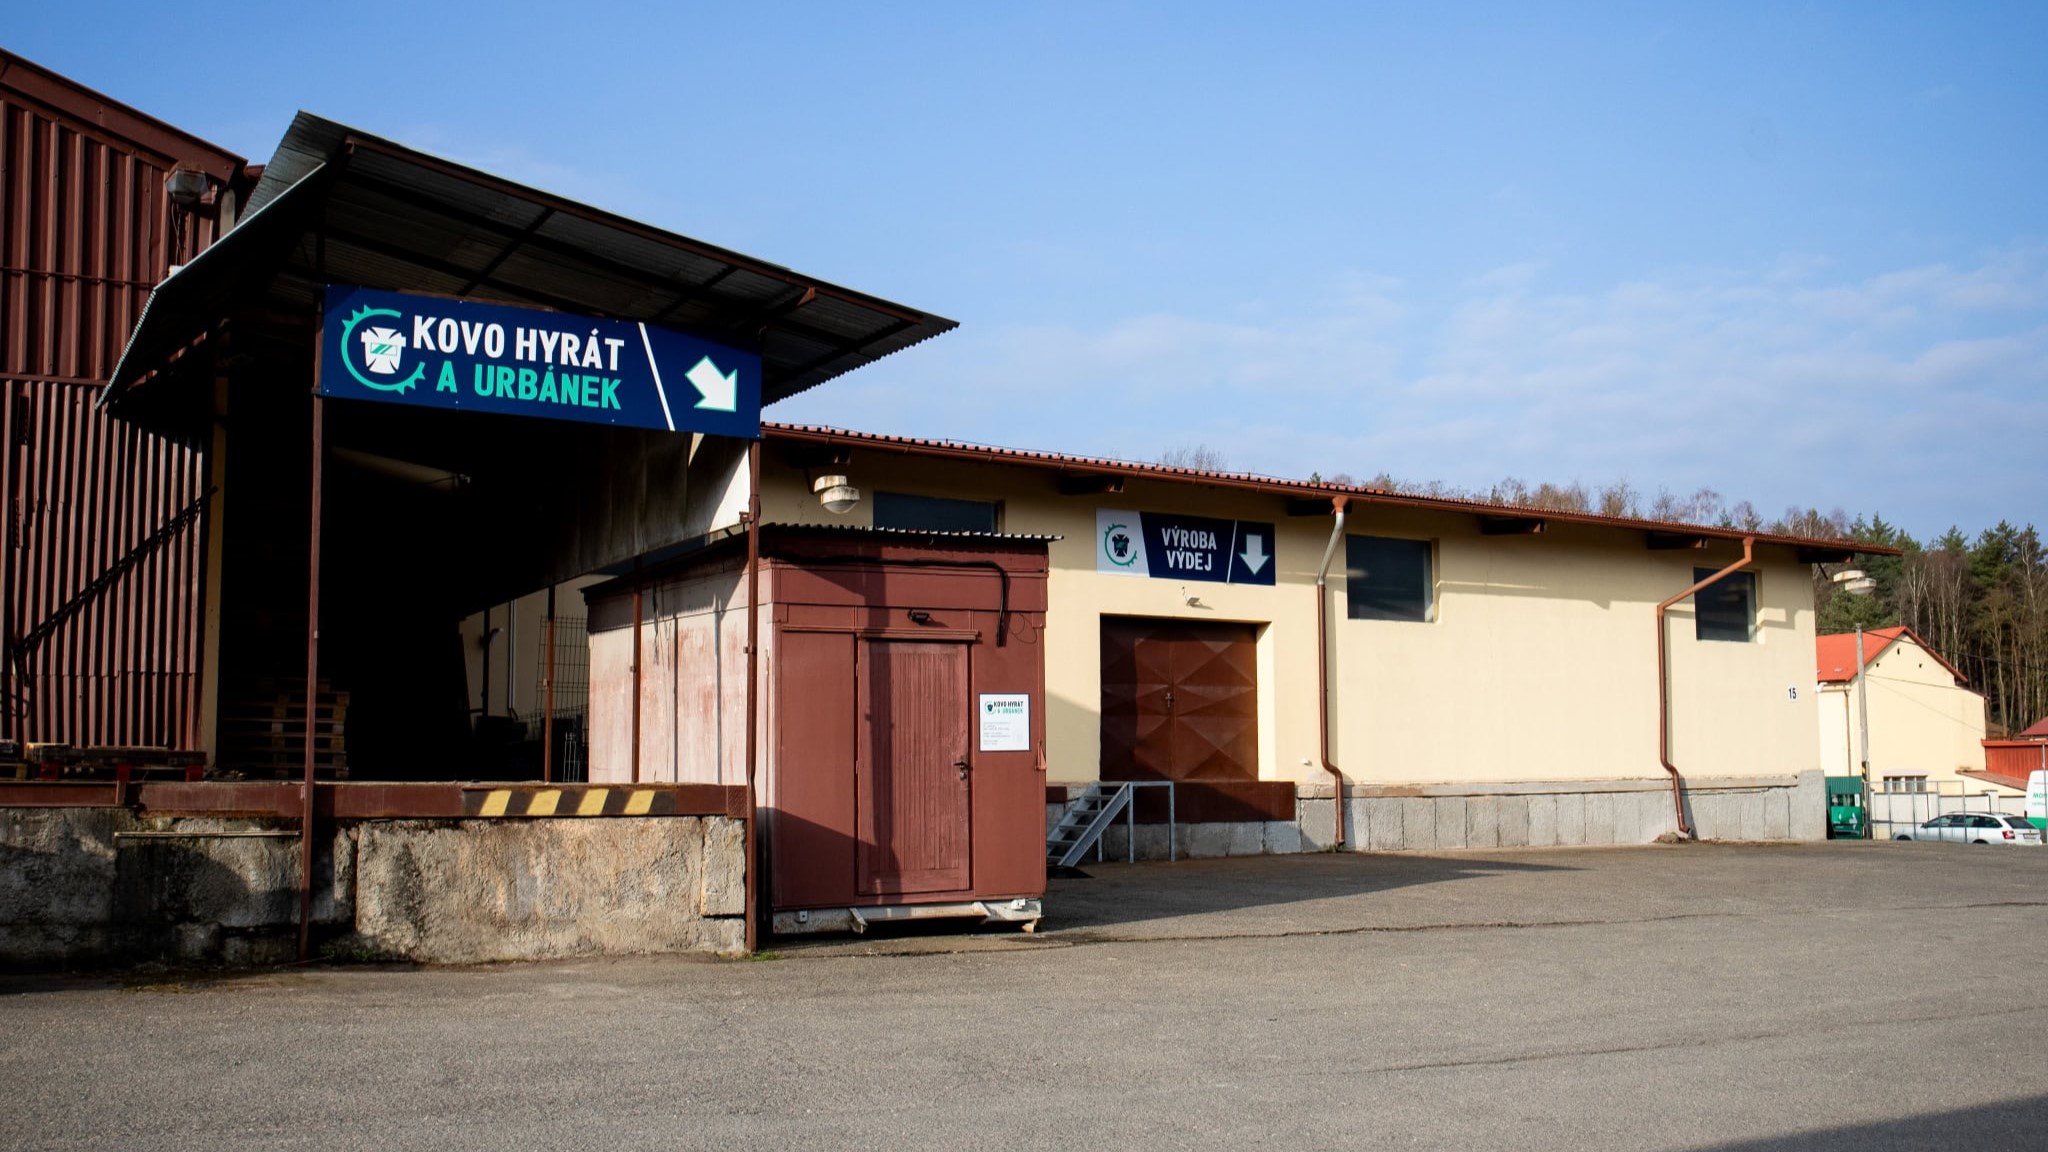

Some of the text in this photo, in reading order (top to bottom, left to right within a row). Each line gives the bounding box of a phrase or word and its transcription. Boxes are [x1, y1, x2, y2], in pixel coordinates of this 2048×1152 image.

[413, 315, 625, 371] KOVO HYRÁT
[436, 360, 622, 410] A URBÁNEK
[1161, 525, 1217, 550] VÝROBA
[1166, 548, 1212, 572] VÝDEJ
[1788, 687, 1797, 699] 15
